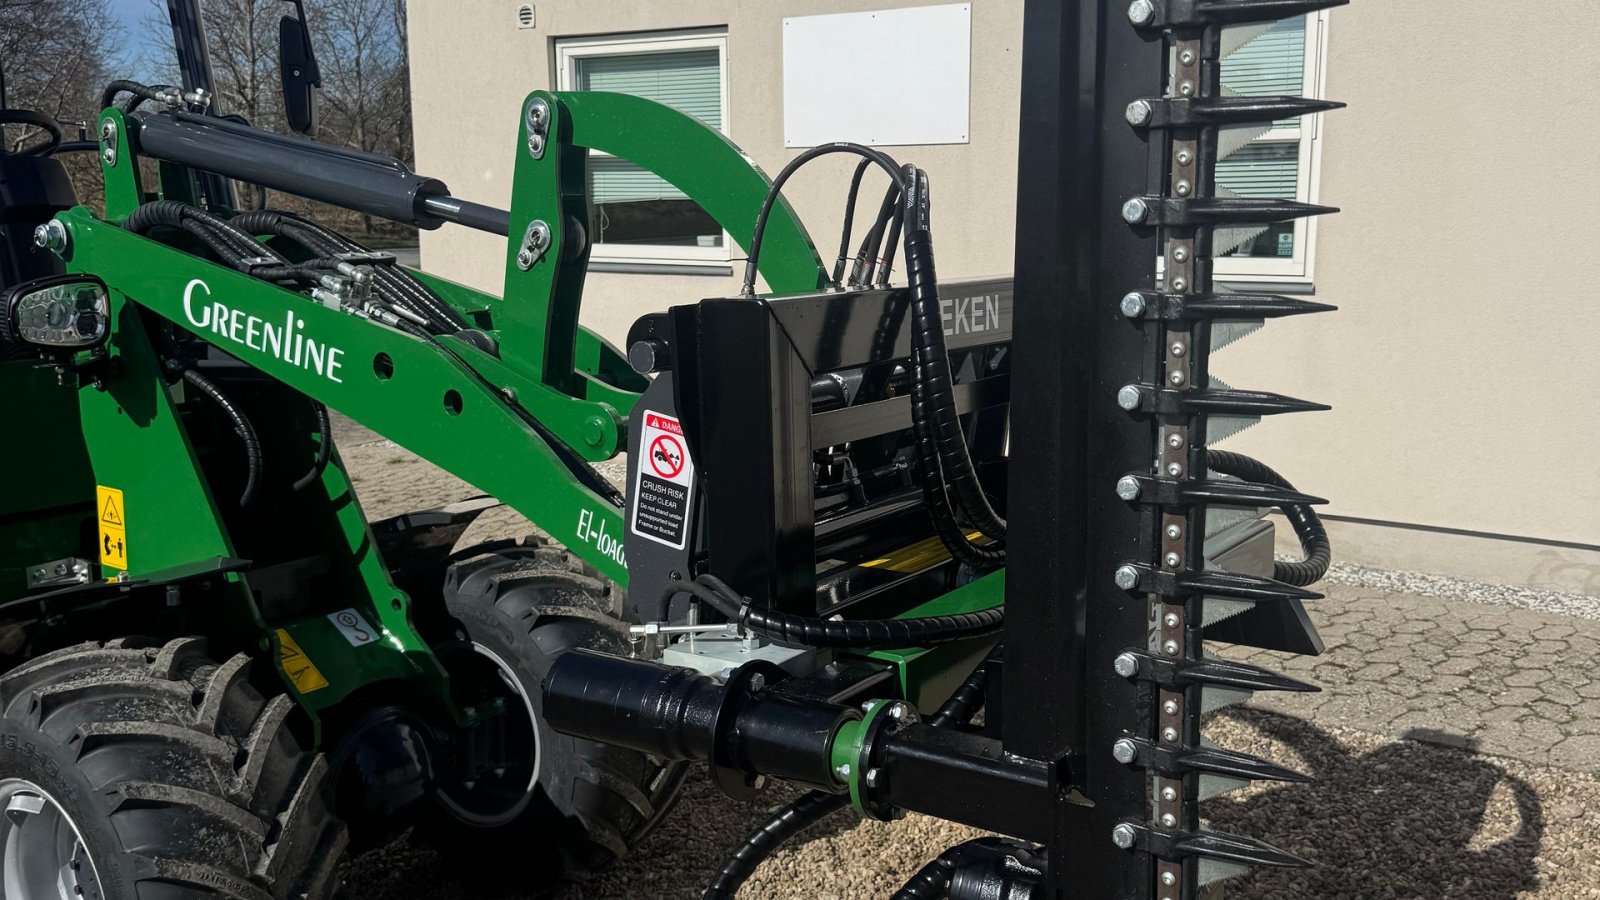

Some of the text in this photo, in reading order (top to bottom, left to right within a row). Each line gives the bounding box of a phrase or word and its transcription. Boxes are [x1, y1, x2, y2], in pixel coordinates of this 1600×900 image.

[661, 421, 684, 435] DANG
[642, 480, 684, 500] CRUSH RISK
[641, 492, 677, 509] KEEP CLEAR
[640, 502, 648, 510] Do
[655, 508, 669, 517] stand
[669, 513, 683, 521] under
[638, 519, 653, 529] Frame
[639, 512, 679, 530] unsupported load
